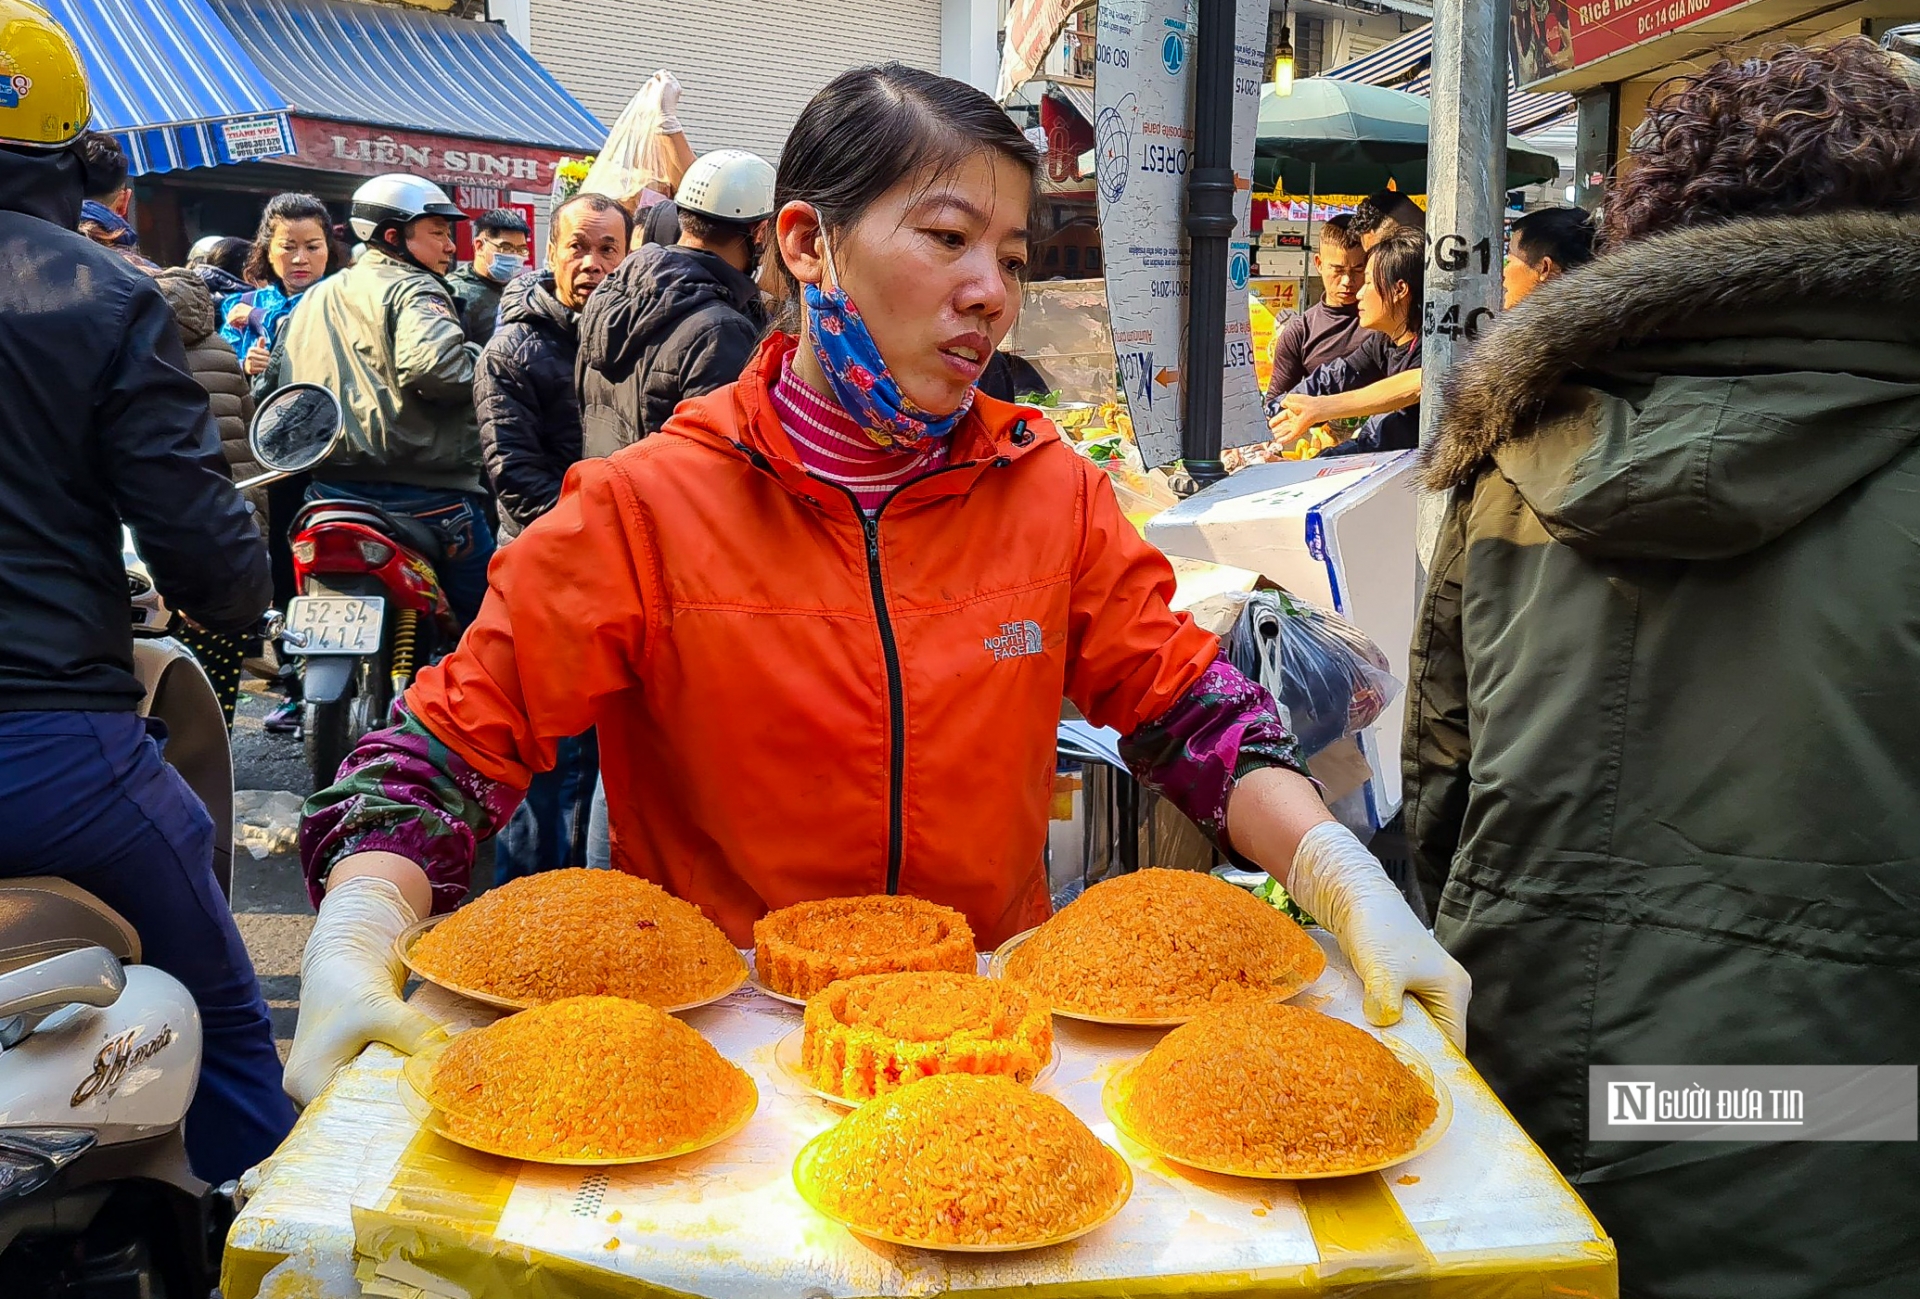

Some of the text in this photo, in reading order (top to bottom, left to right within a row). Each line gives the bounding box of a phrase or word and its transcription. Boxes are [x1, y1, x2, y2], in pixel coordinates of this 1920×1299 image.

[1579, 1, 1611, 27] Rice
[1639, 12, 1654, 35] ĐC:
[1655, 8, 1667, 28] 14
[1668, 1, 1686, 23] GIA
[1114, 48, 1130, 69] ISO
[330, 135, 538, 180] LIÊN SINH
[460, 186, 499, 210] SINH
[1274, 284, 1294, 302] 14
[999, 621, 1024, 635] THE
[983, 632, 1025, 650] NORTH
[993, 644, 1027, 662] FACE
